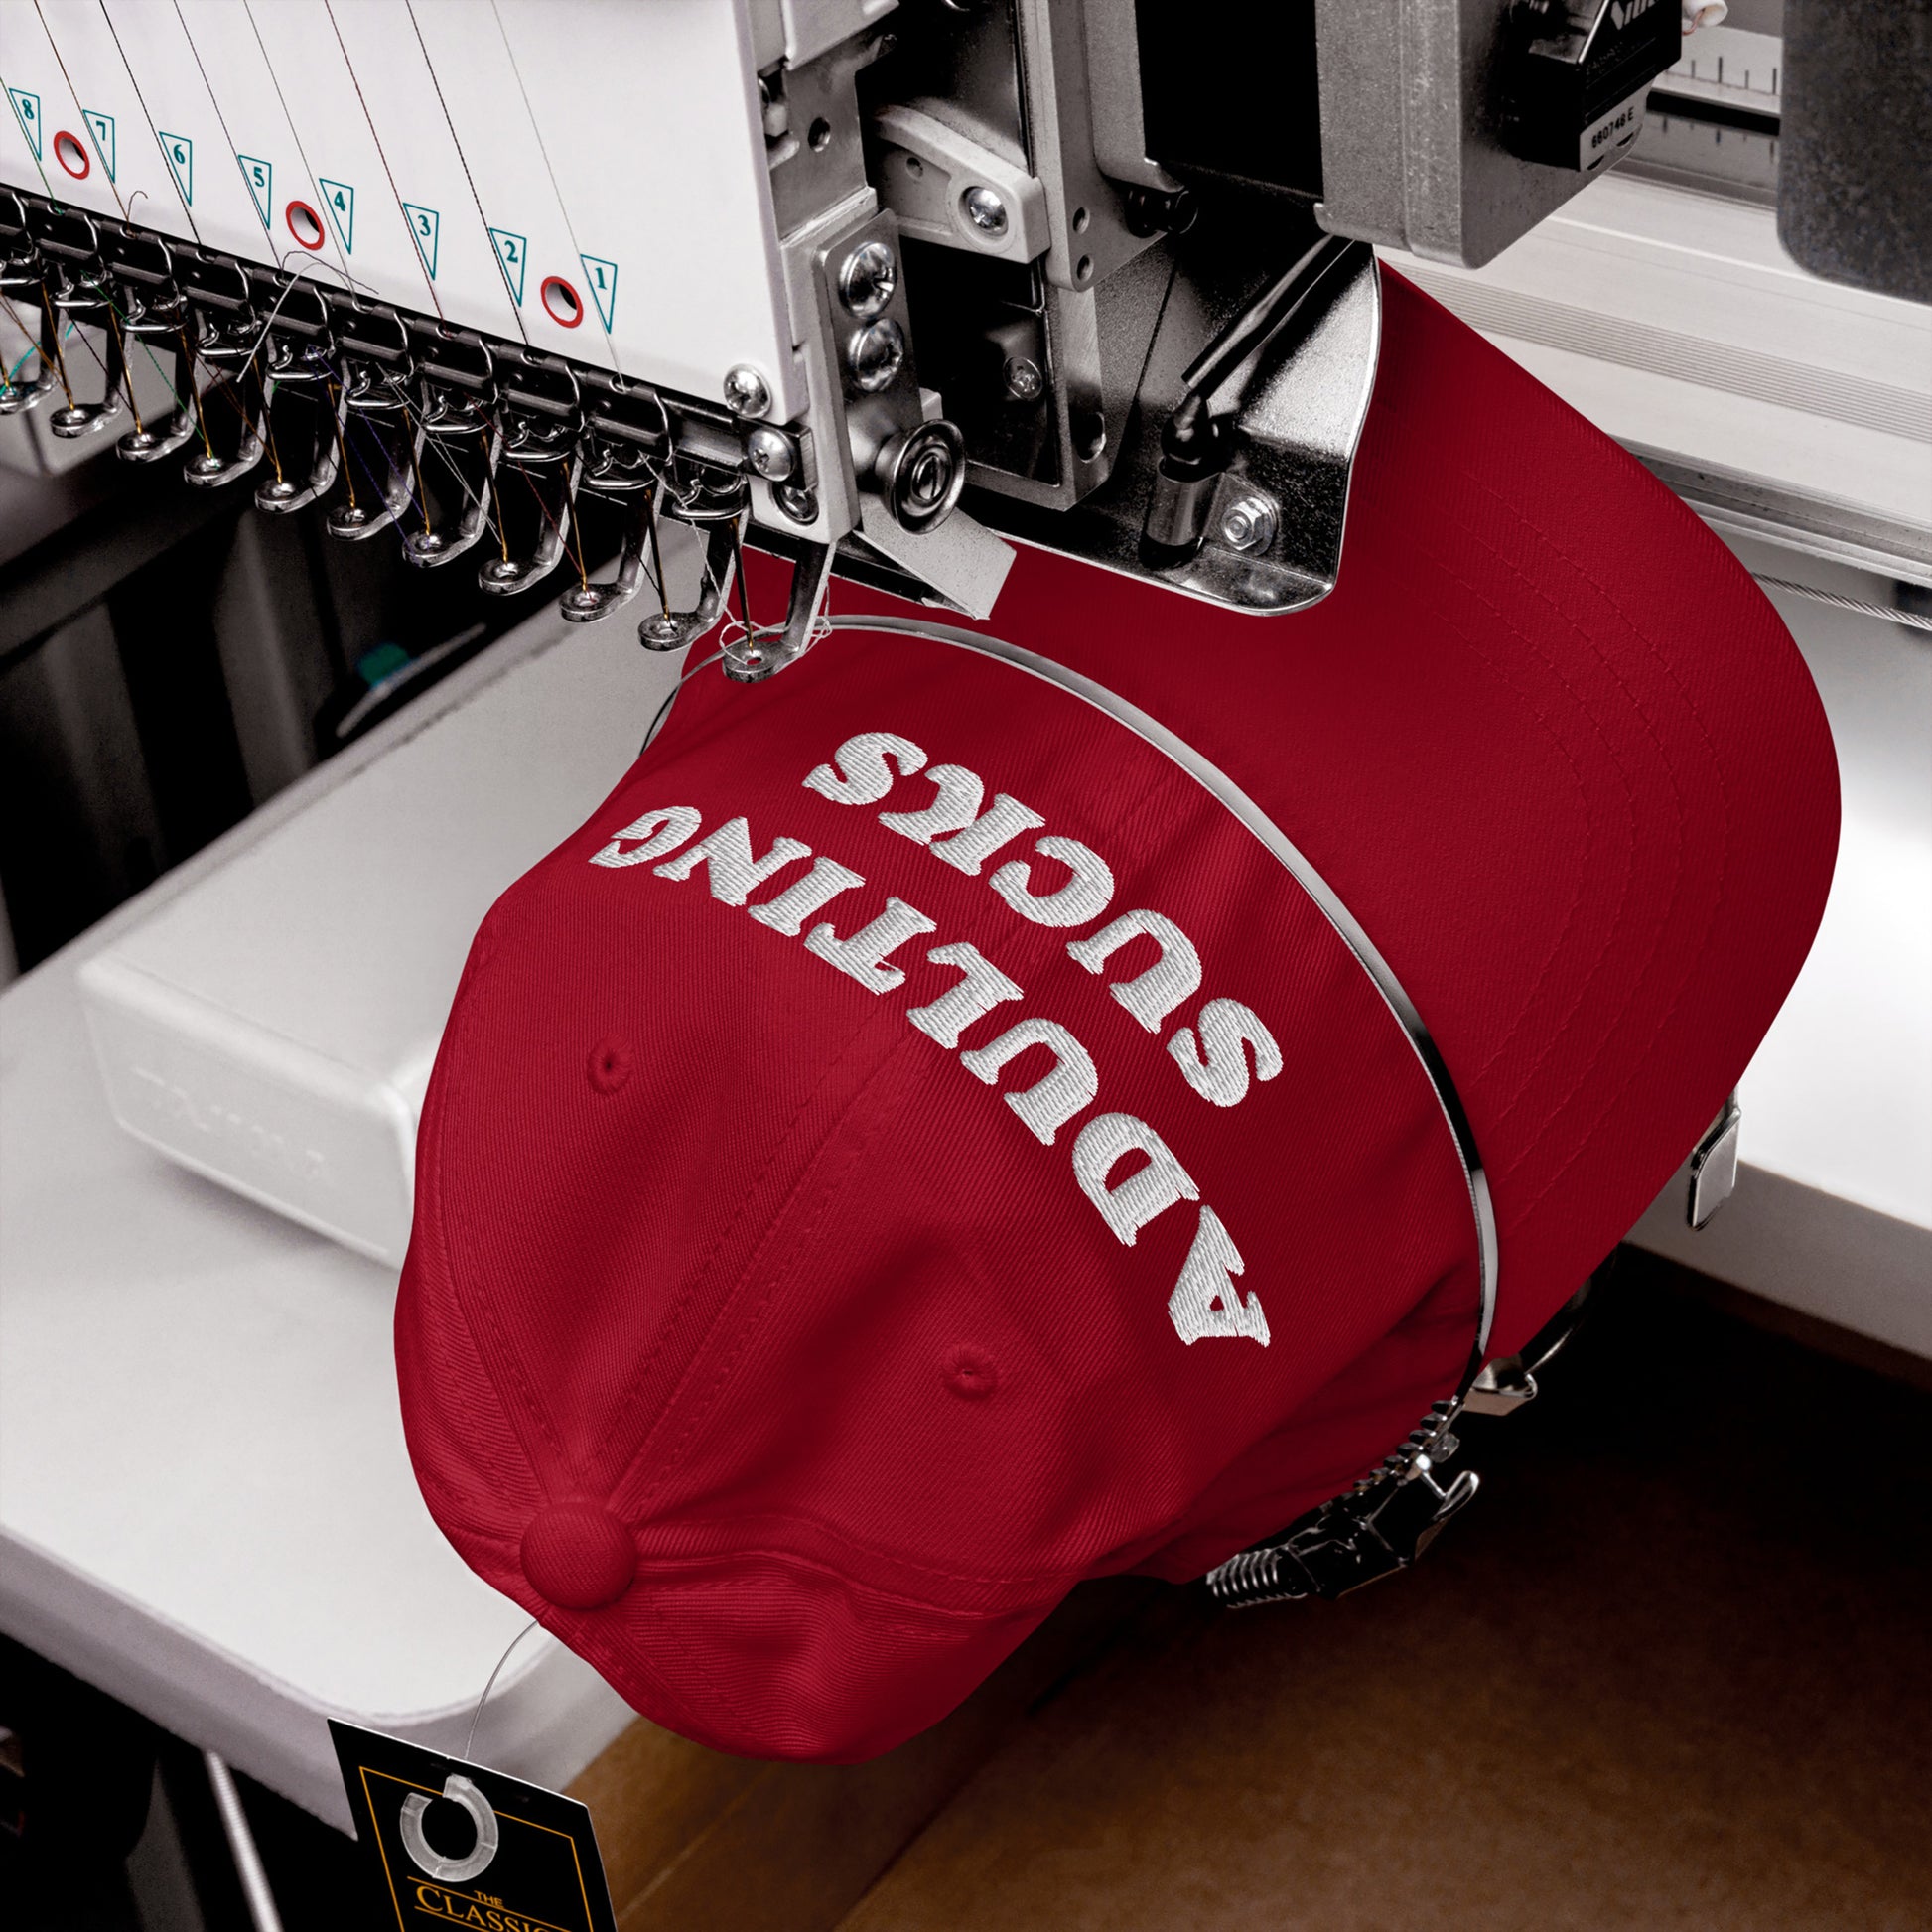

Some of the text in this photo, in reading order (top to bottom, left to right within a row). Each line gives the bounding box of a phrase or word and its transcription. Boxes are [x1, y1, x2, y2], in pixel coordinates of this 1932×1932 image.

[22, 98, 35, 120] 8
[1627, 105, 1635, 121] E
[96, 120, 106, 141] 7
[173, 144, 186, 165] 6
[253, 166, 265, 188] 5
[334, 191, 346, 212] 4
[417, 214, 431, 237] 3
[504, 240, 518, 264] 2
[595, 267, 608, 290] 1
[802, 732, 1284, 1107] SUCKS
[589, 806, 1272, 1348] ADULTING
[416, 1885, 550, 1932] CLASSI
[474, 1890, 504, 1909] THE
